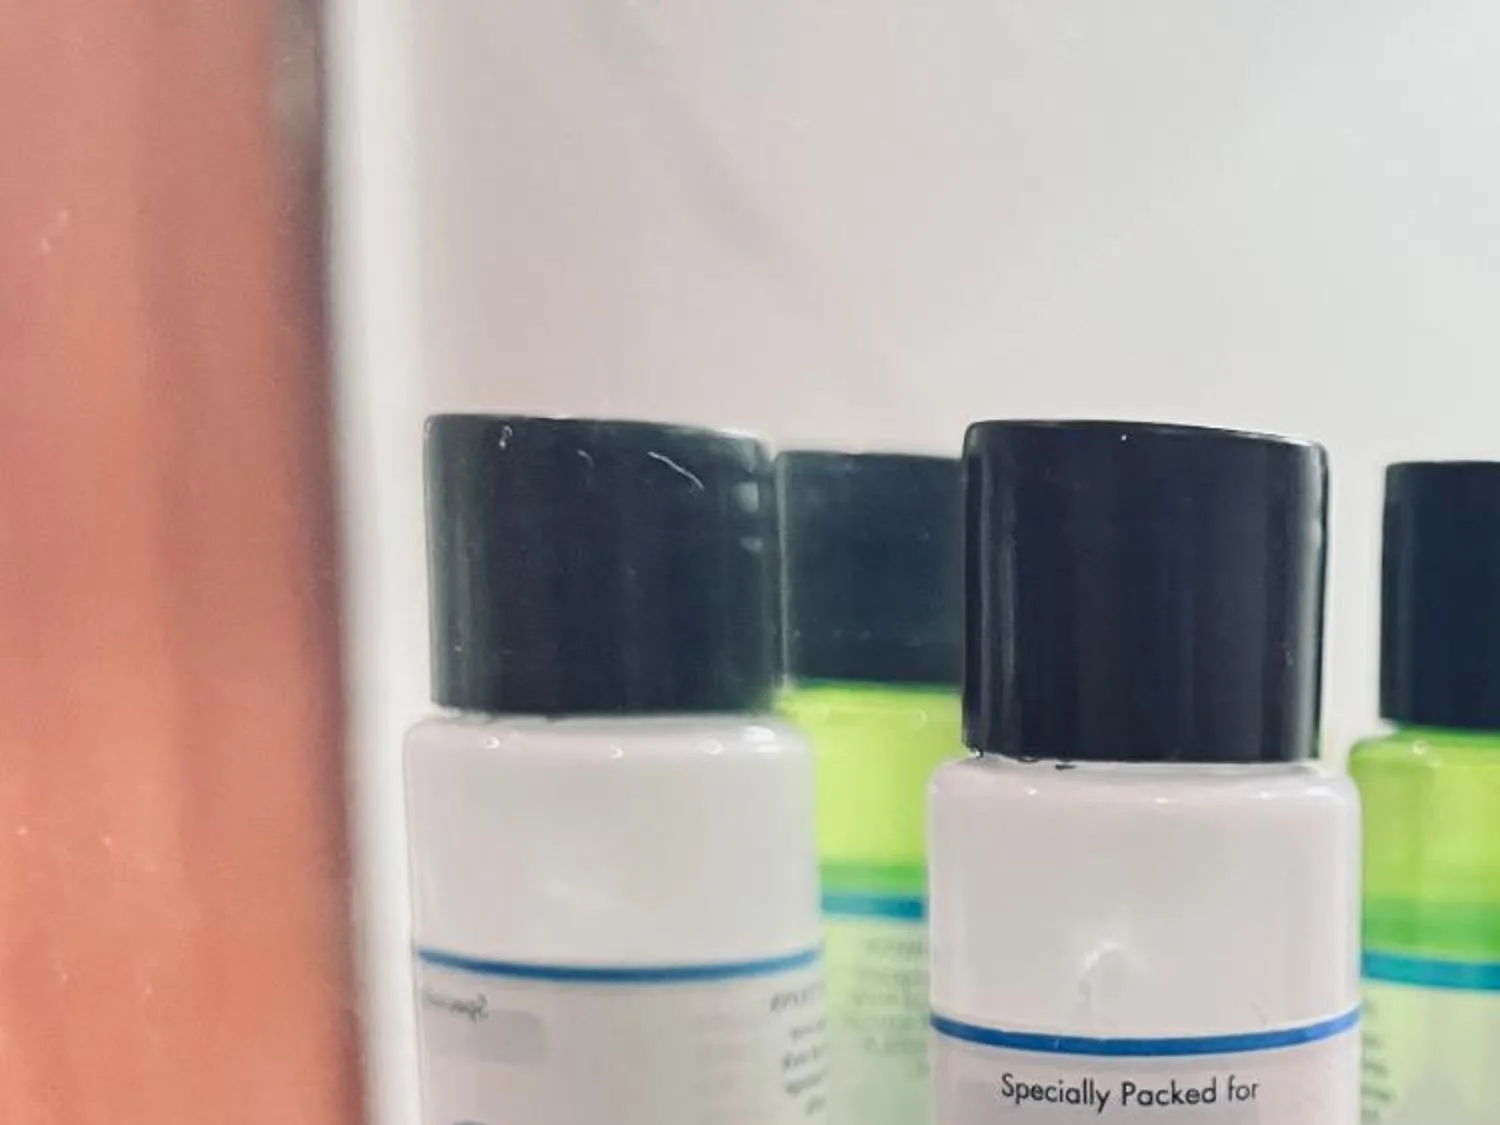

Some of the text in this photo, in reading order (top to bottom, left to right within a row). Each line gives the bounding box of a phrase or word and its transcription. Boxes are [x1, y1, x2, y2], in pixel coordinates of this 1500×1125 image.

[1001, 1072, 1260, 1114] Specially Packed for
